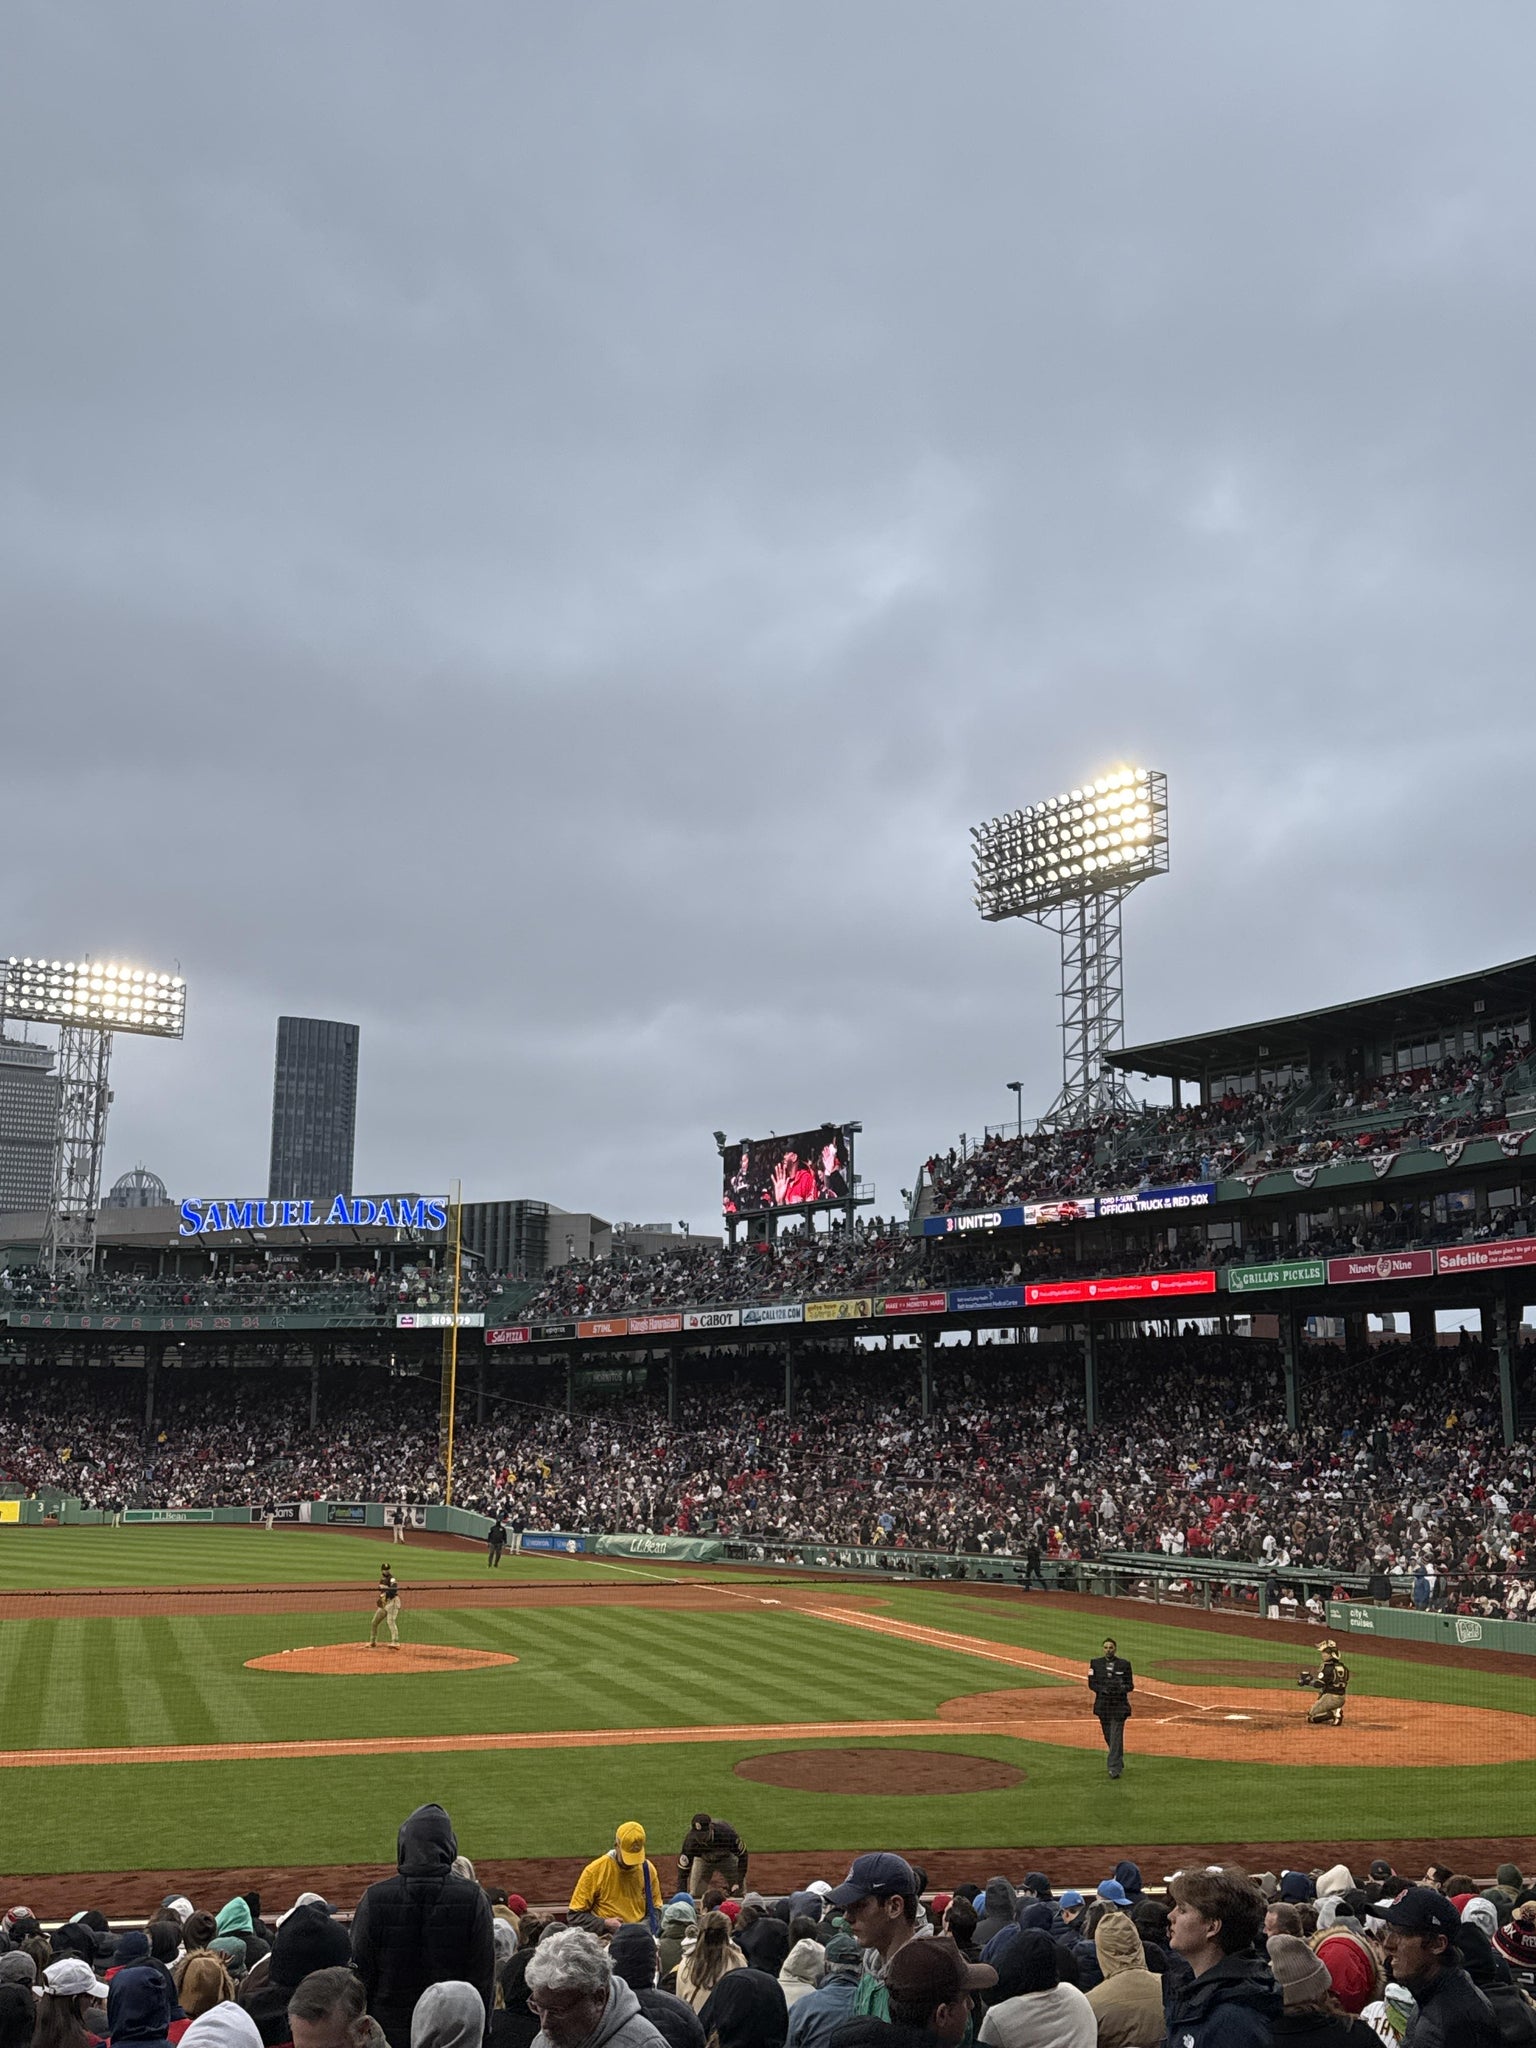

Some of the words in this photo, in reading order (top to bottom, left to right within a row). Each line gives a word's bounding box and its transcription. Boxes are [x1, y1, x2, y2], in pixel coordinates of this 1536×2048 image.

[1100, 1197, 1115, 1205] FORD
[1116, 1194, 1138, 1204] F-SERIES
[1101, 1203, 1135, 1216] OFFICIAL
[1136, 1199, 1163, 1211] TRUCK
[1173, 1196, 1189, 1207] RED
[1191, 1193, 1208, 1205] SOX
[179, 1196, 321, 1236] SAMUEL
[324, 1193, 448, 1231] ADAMS
[958, 1212, 1002, 1231] UNITED
[1440, 1252, 1489, 1268] Safelite
[1243, 1272, 1280, 1284] GRILLO'S
[1282, 1267, 1321, 1282] PICKLES
[1348, 1264, 1376, 1275] Ninety
[1392, 1261, 1412, 1271] Nine
[20, 1314, 30, 1326] 9
[63, 1316, 69, 1328] 1
[102, 1316, 121, 1329] 27
[160, 1318, 174, 1330] 14
[185, 1317, 203, 1330] 45
[271, 1316, 285, 1328] 42
[592, 1324, 612, 1334] STIHL
[649, 1318, 679, 1330] Hawaiian
[506, 1331, 523, 1342] PIZZA
[630, 1539, 667, 1554] L.L.Bean
[1350, 1619, 1374, 1628] cruises
